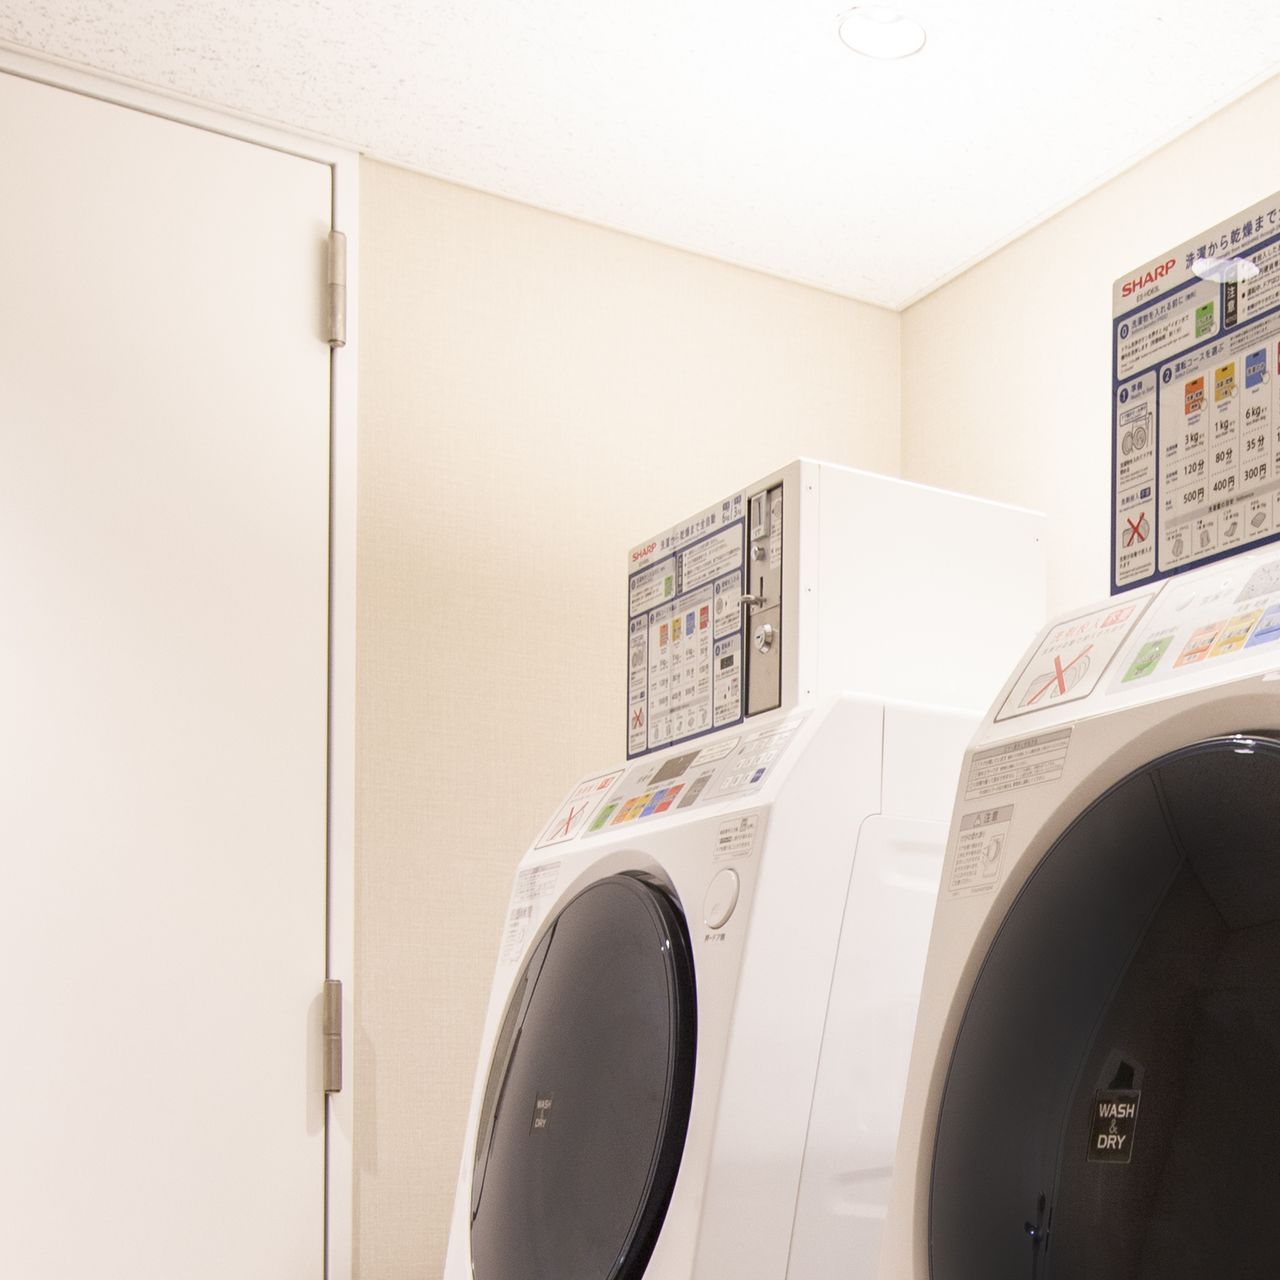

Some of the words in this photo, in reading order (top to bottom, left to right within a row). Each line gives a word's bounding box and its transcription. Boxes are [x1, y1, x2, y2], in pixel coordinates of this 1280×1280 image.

[1122, 258, 1176, 298] SHARP
[1246, 435, 1265, 451] 35分
[1215, 448, 1233, 463] 80分
[1183, 459, 1205, 475] 120分
[1244, 463, 1267, 481] 300円
[1213, 475, 1235, 492] 400円
[1183, 487, 1205, 504] 500円
[632, 542, 657, 562] SHARP
[1099, 1103, 1136, 1119] WASH
[1108, 1118, 1118, 1134] &
[1097, 1134, 1126, 1150] DRY
